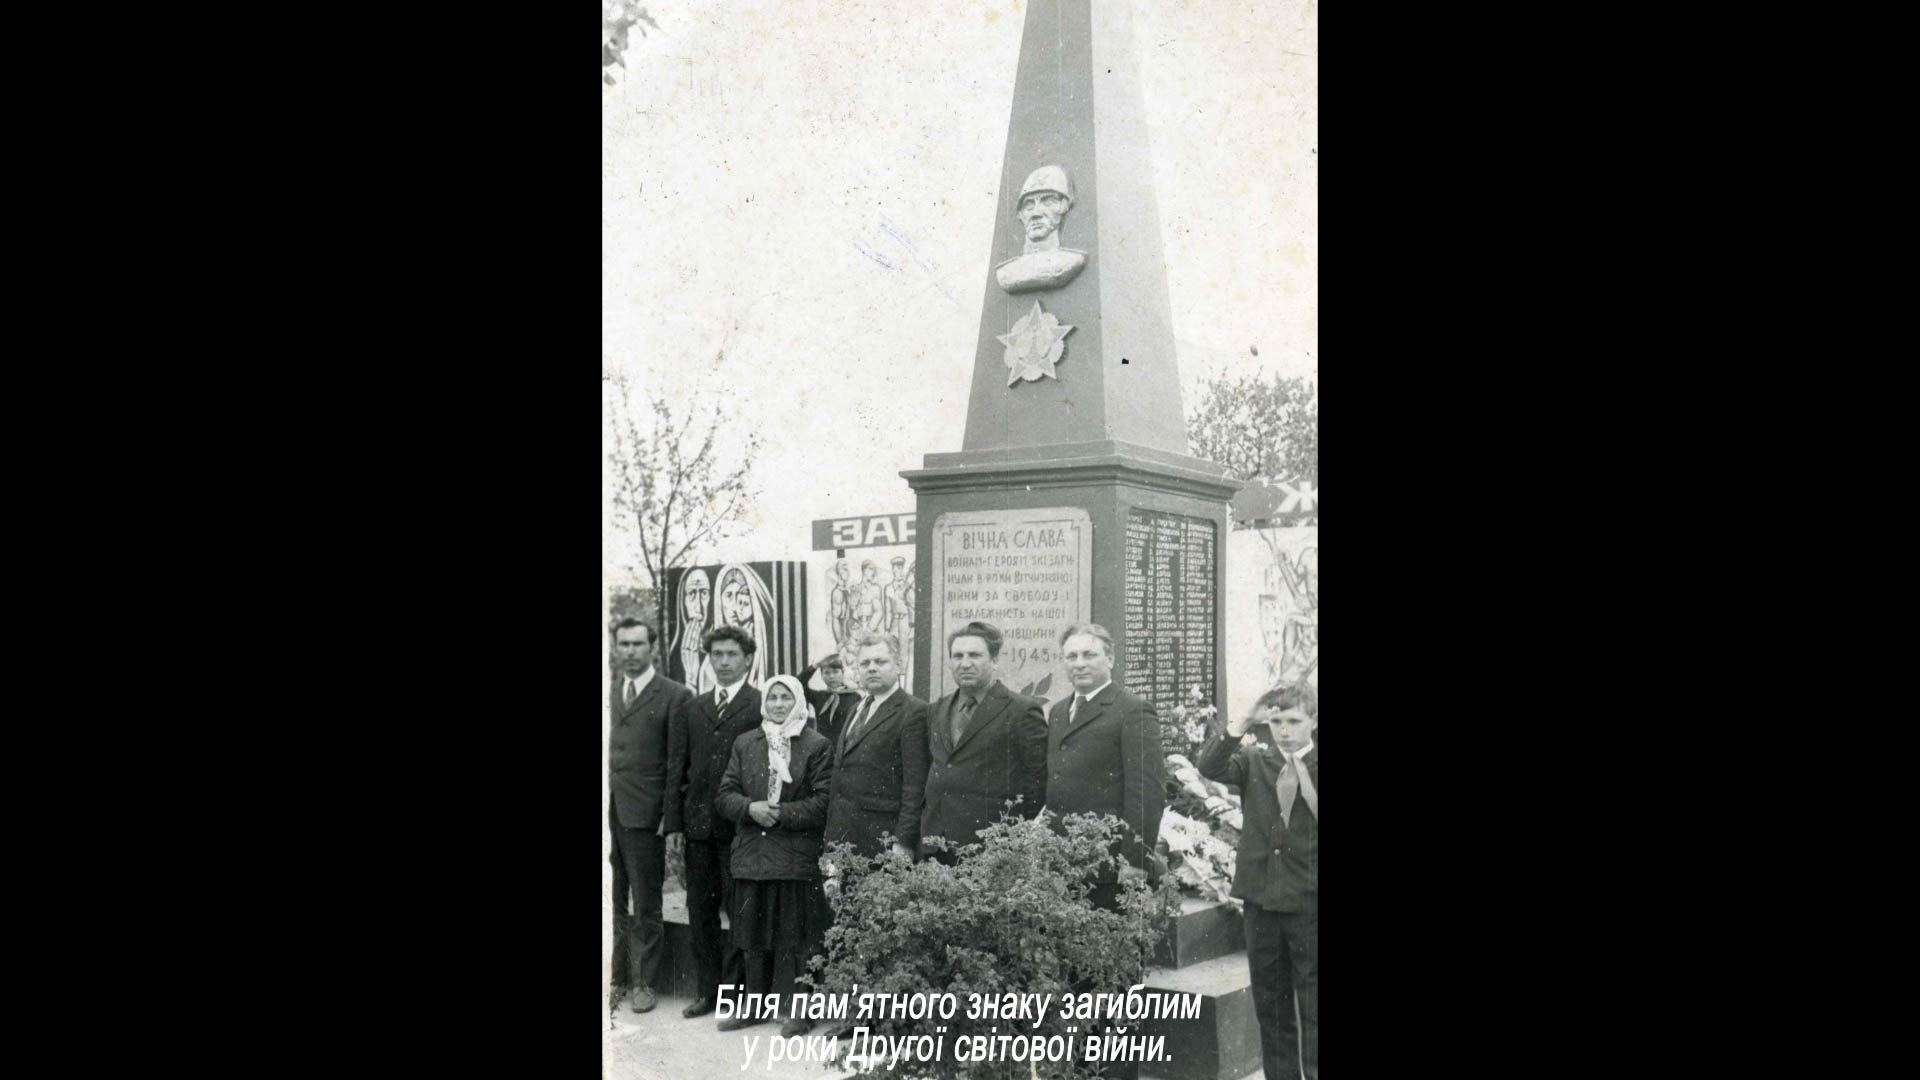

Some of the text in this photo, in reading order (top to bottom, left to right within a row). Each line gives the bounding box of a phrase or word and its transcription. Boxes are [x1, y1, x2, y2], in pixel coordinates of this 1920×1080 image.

[963, 529, 1066, 550] ВІЧНА СЛАВА
[977, 573, 982, 584] В
[986, 572, 1011, 584] РОКИ
[986, 591, 998, 601] ЗА
[1005, 590, 1058, 602] СВОБОДУ
[952, 607, 1025, 619] НЕЗАЛЕЖНІСТЬ
[1003, 628, 1056, 639] КІВЩИНИ
